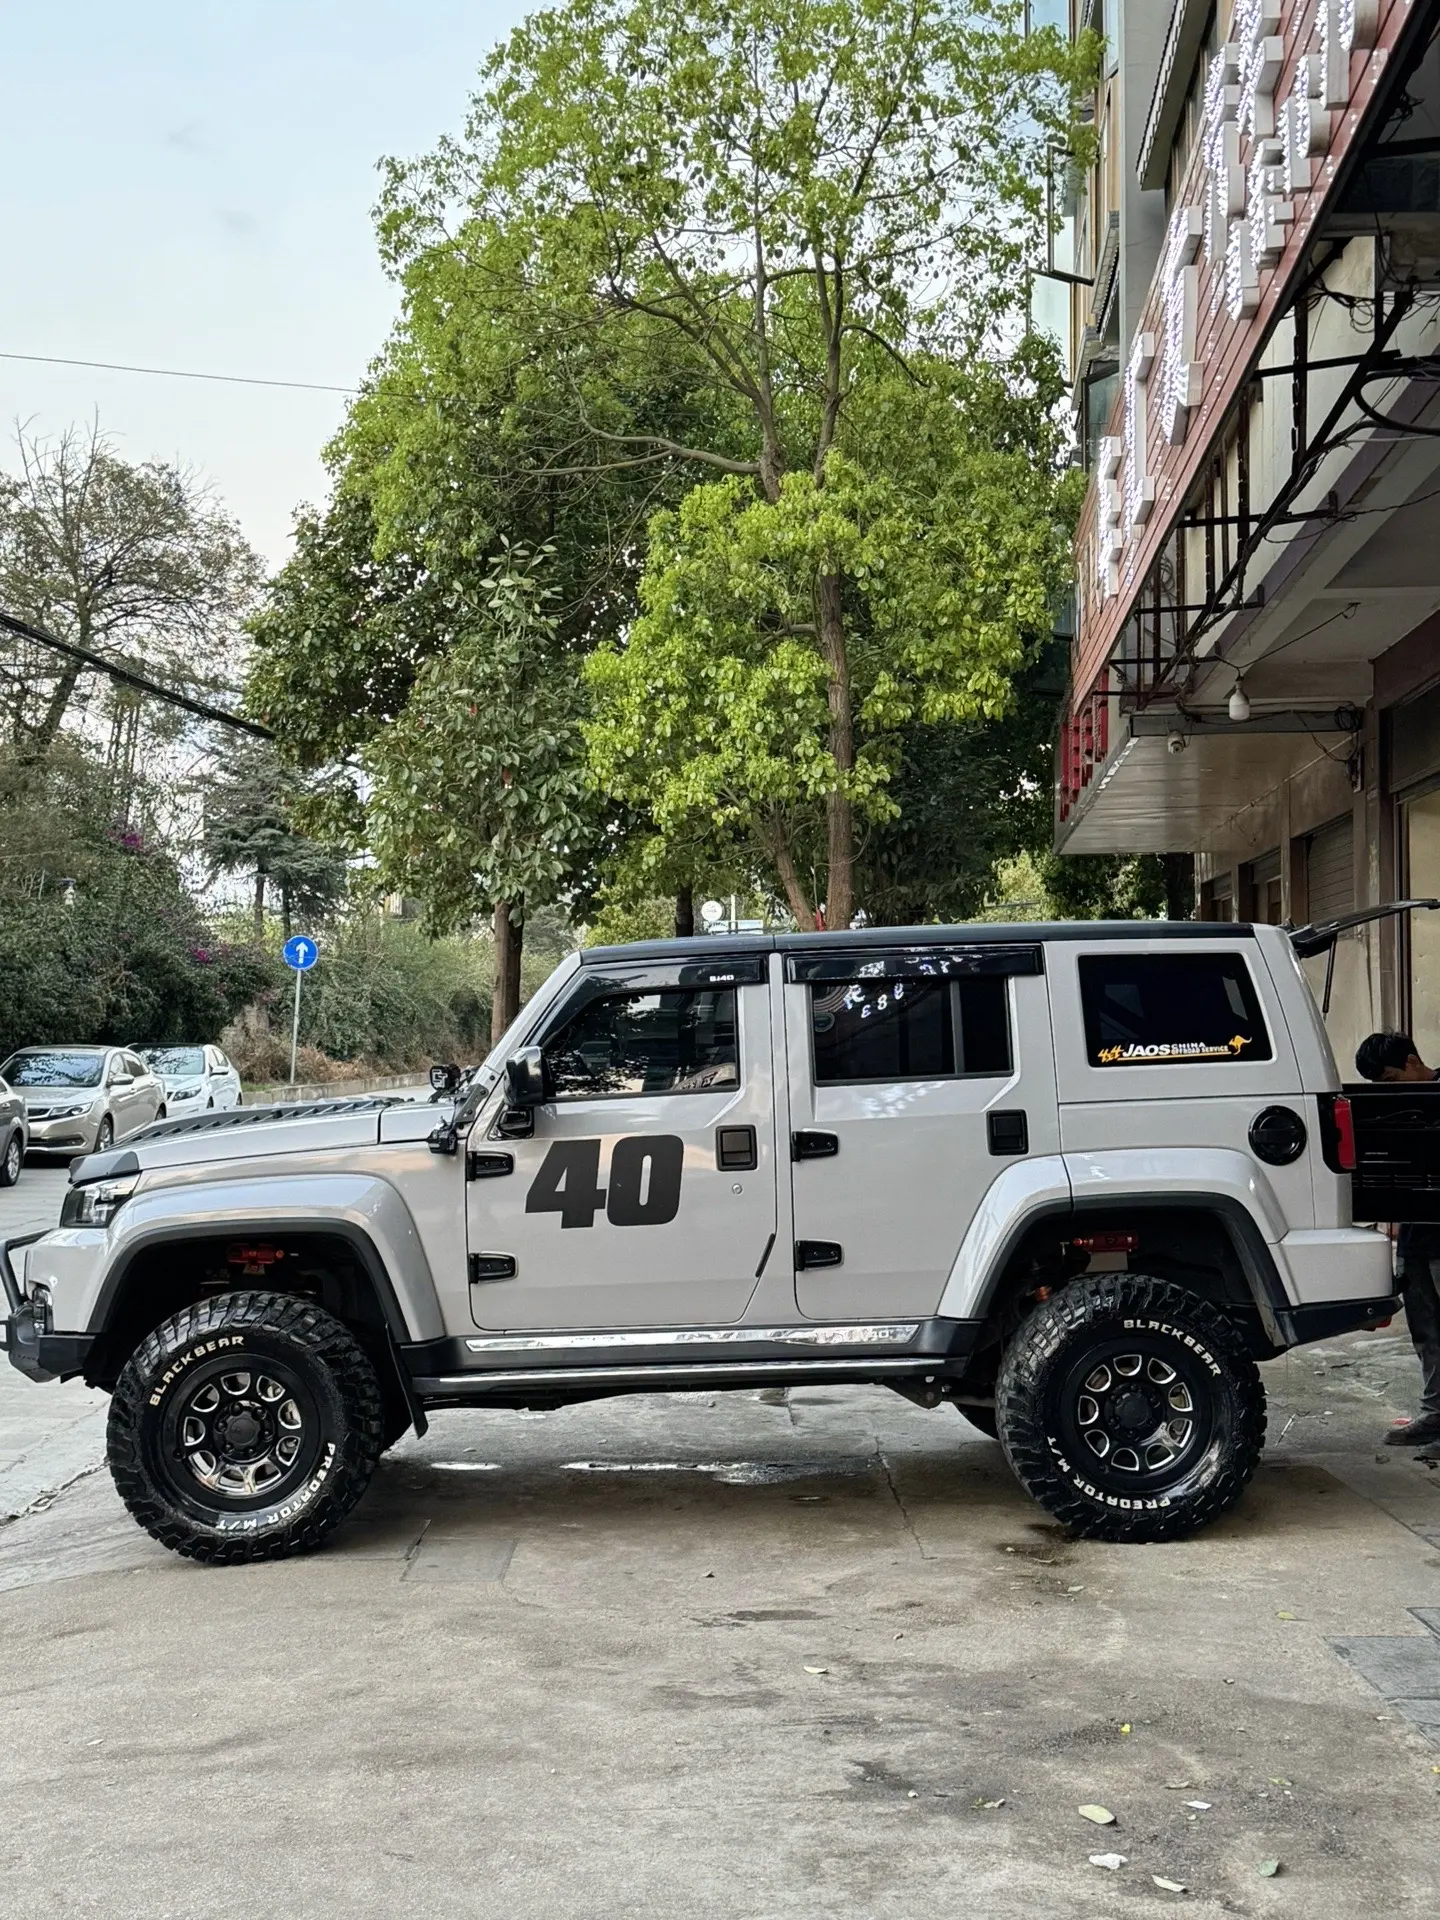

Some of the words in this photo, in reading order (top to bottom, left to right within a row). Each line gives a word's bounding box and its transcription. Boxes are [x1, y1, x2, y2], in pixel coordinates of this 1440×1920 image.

[1122, 1043, 1171, 1057] JAOS
[525, 1134, 684, 1229] 40
[149, 1335, 245, 1406] BLACKBEAR
[1123, 1319, 1222, 1377] BLACKBEAR
[1046, 1436, 1071, 1473] M/T
[266, 1442, 336, 1525] PREDATOR
[1073, 1473, 1171, 1510] PREDATOR
[215, 1518, 257, 1530] M/T
